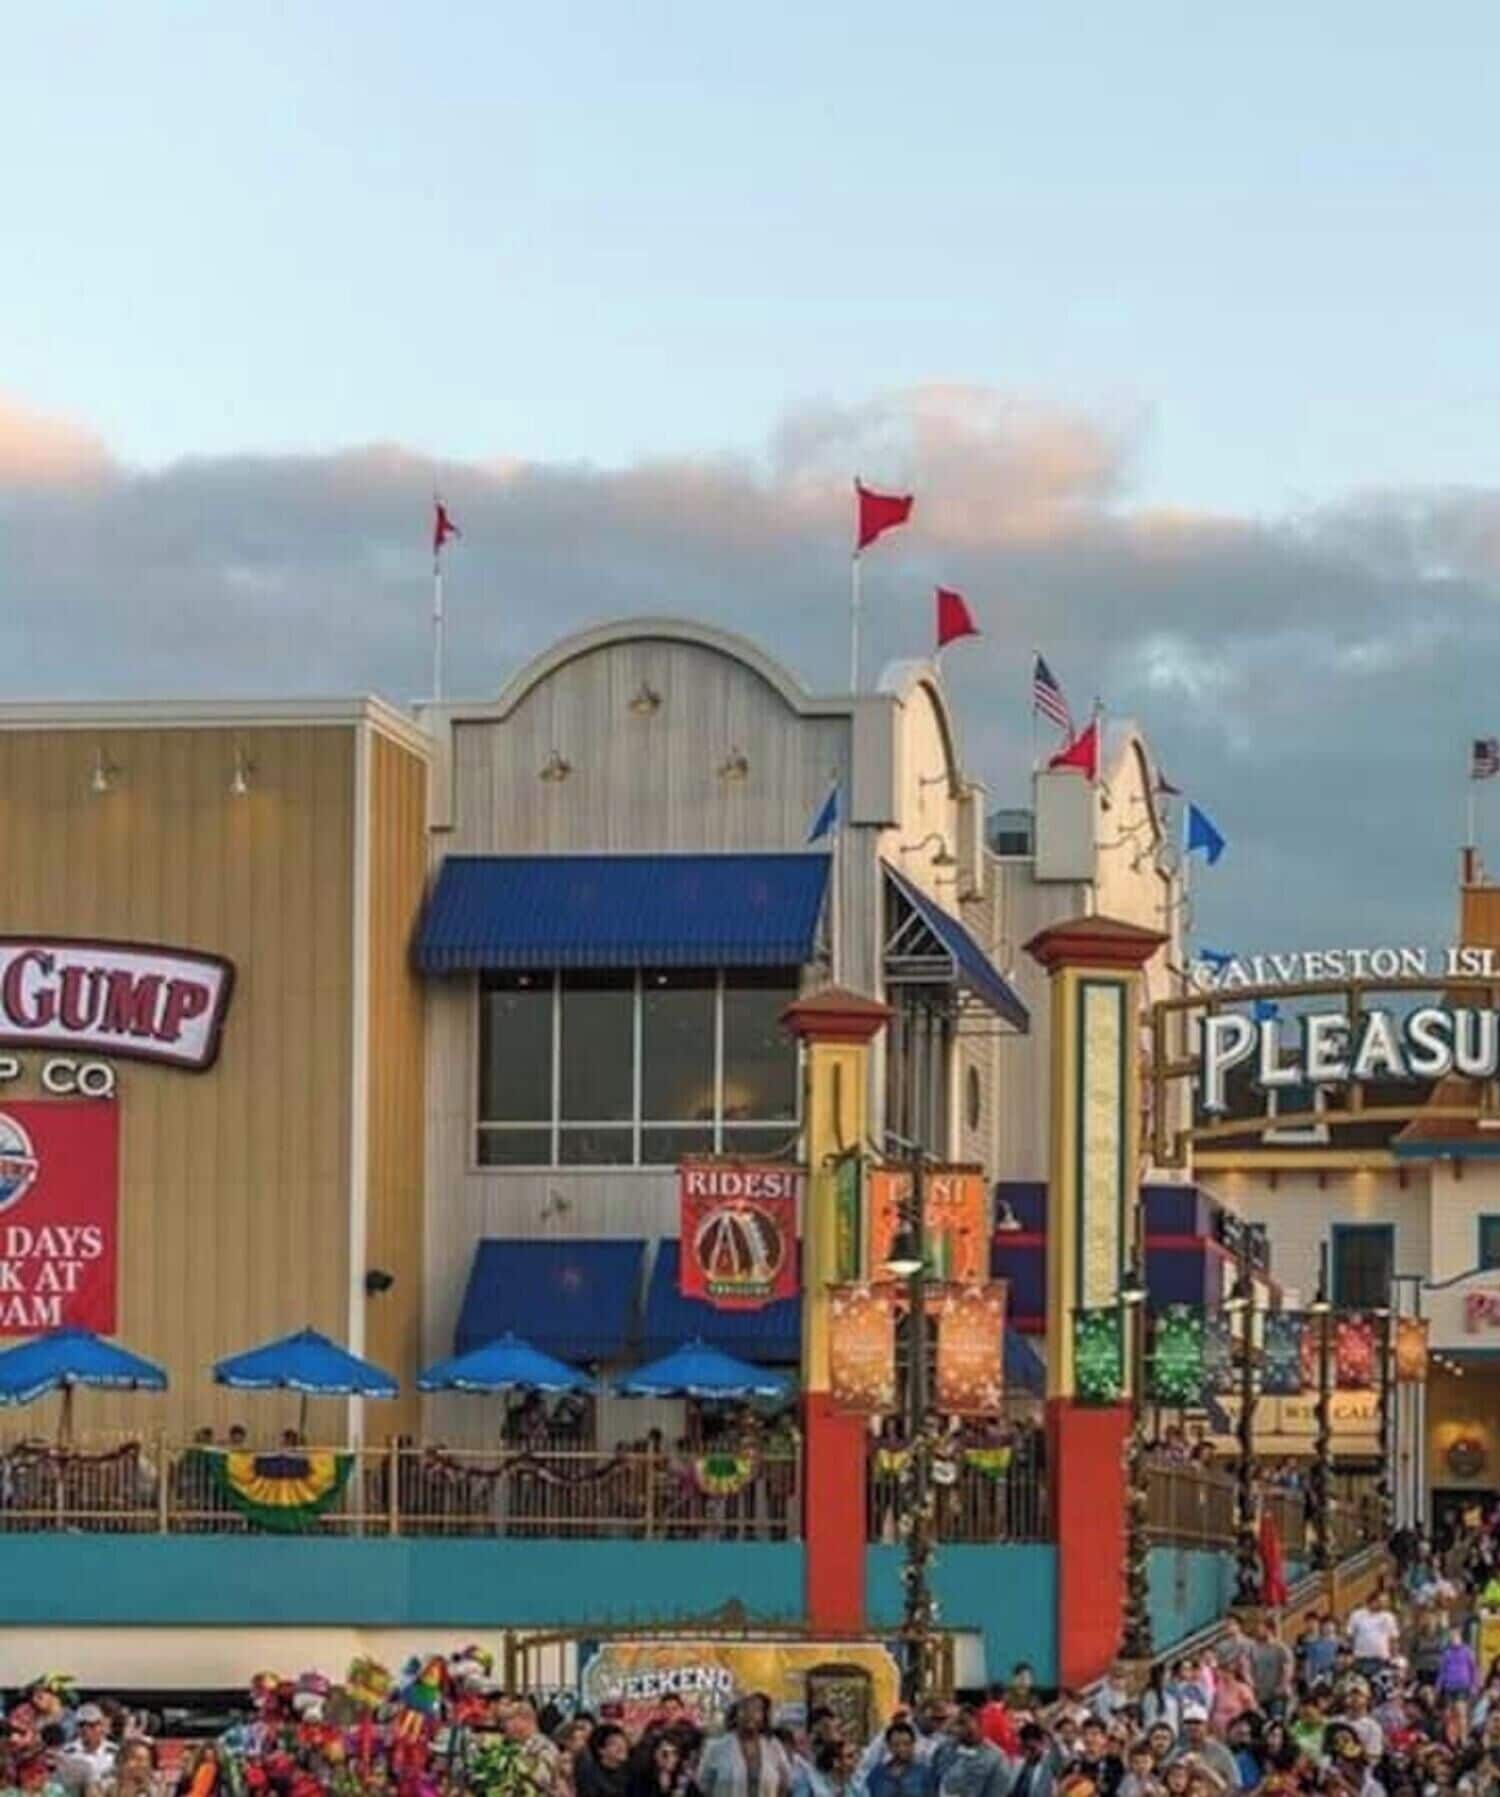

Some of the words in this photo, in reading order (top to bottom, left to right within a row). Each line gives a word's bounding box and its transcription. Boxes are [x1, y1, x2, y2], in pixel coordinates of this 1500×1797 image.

[1192, 948, 1426, 989] GALVESTON
[3, 949, 211, 1043] GUMP
[686, 1171, 795, 1198] RIDES!
[6, 1226, 103, 1259] DAYS
[35, 1261, 84, 1292] AT
[0, 1295, 64, 1327] AM
[600, 1667, 733, 1699] WEEKEND
